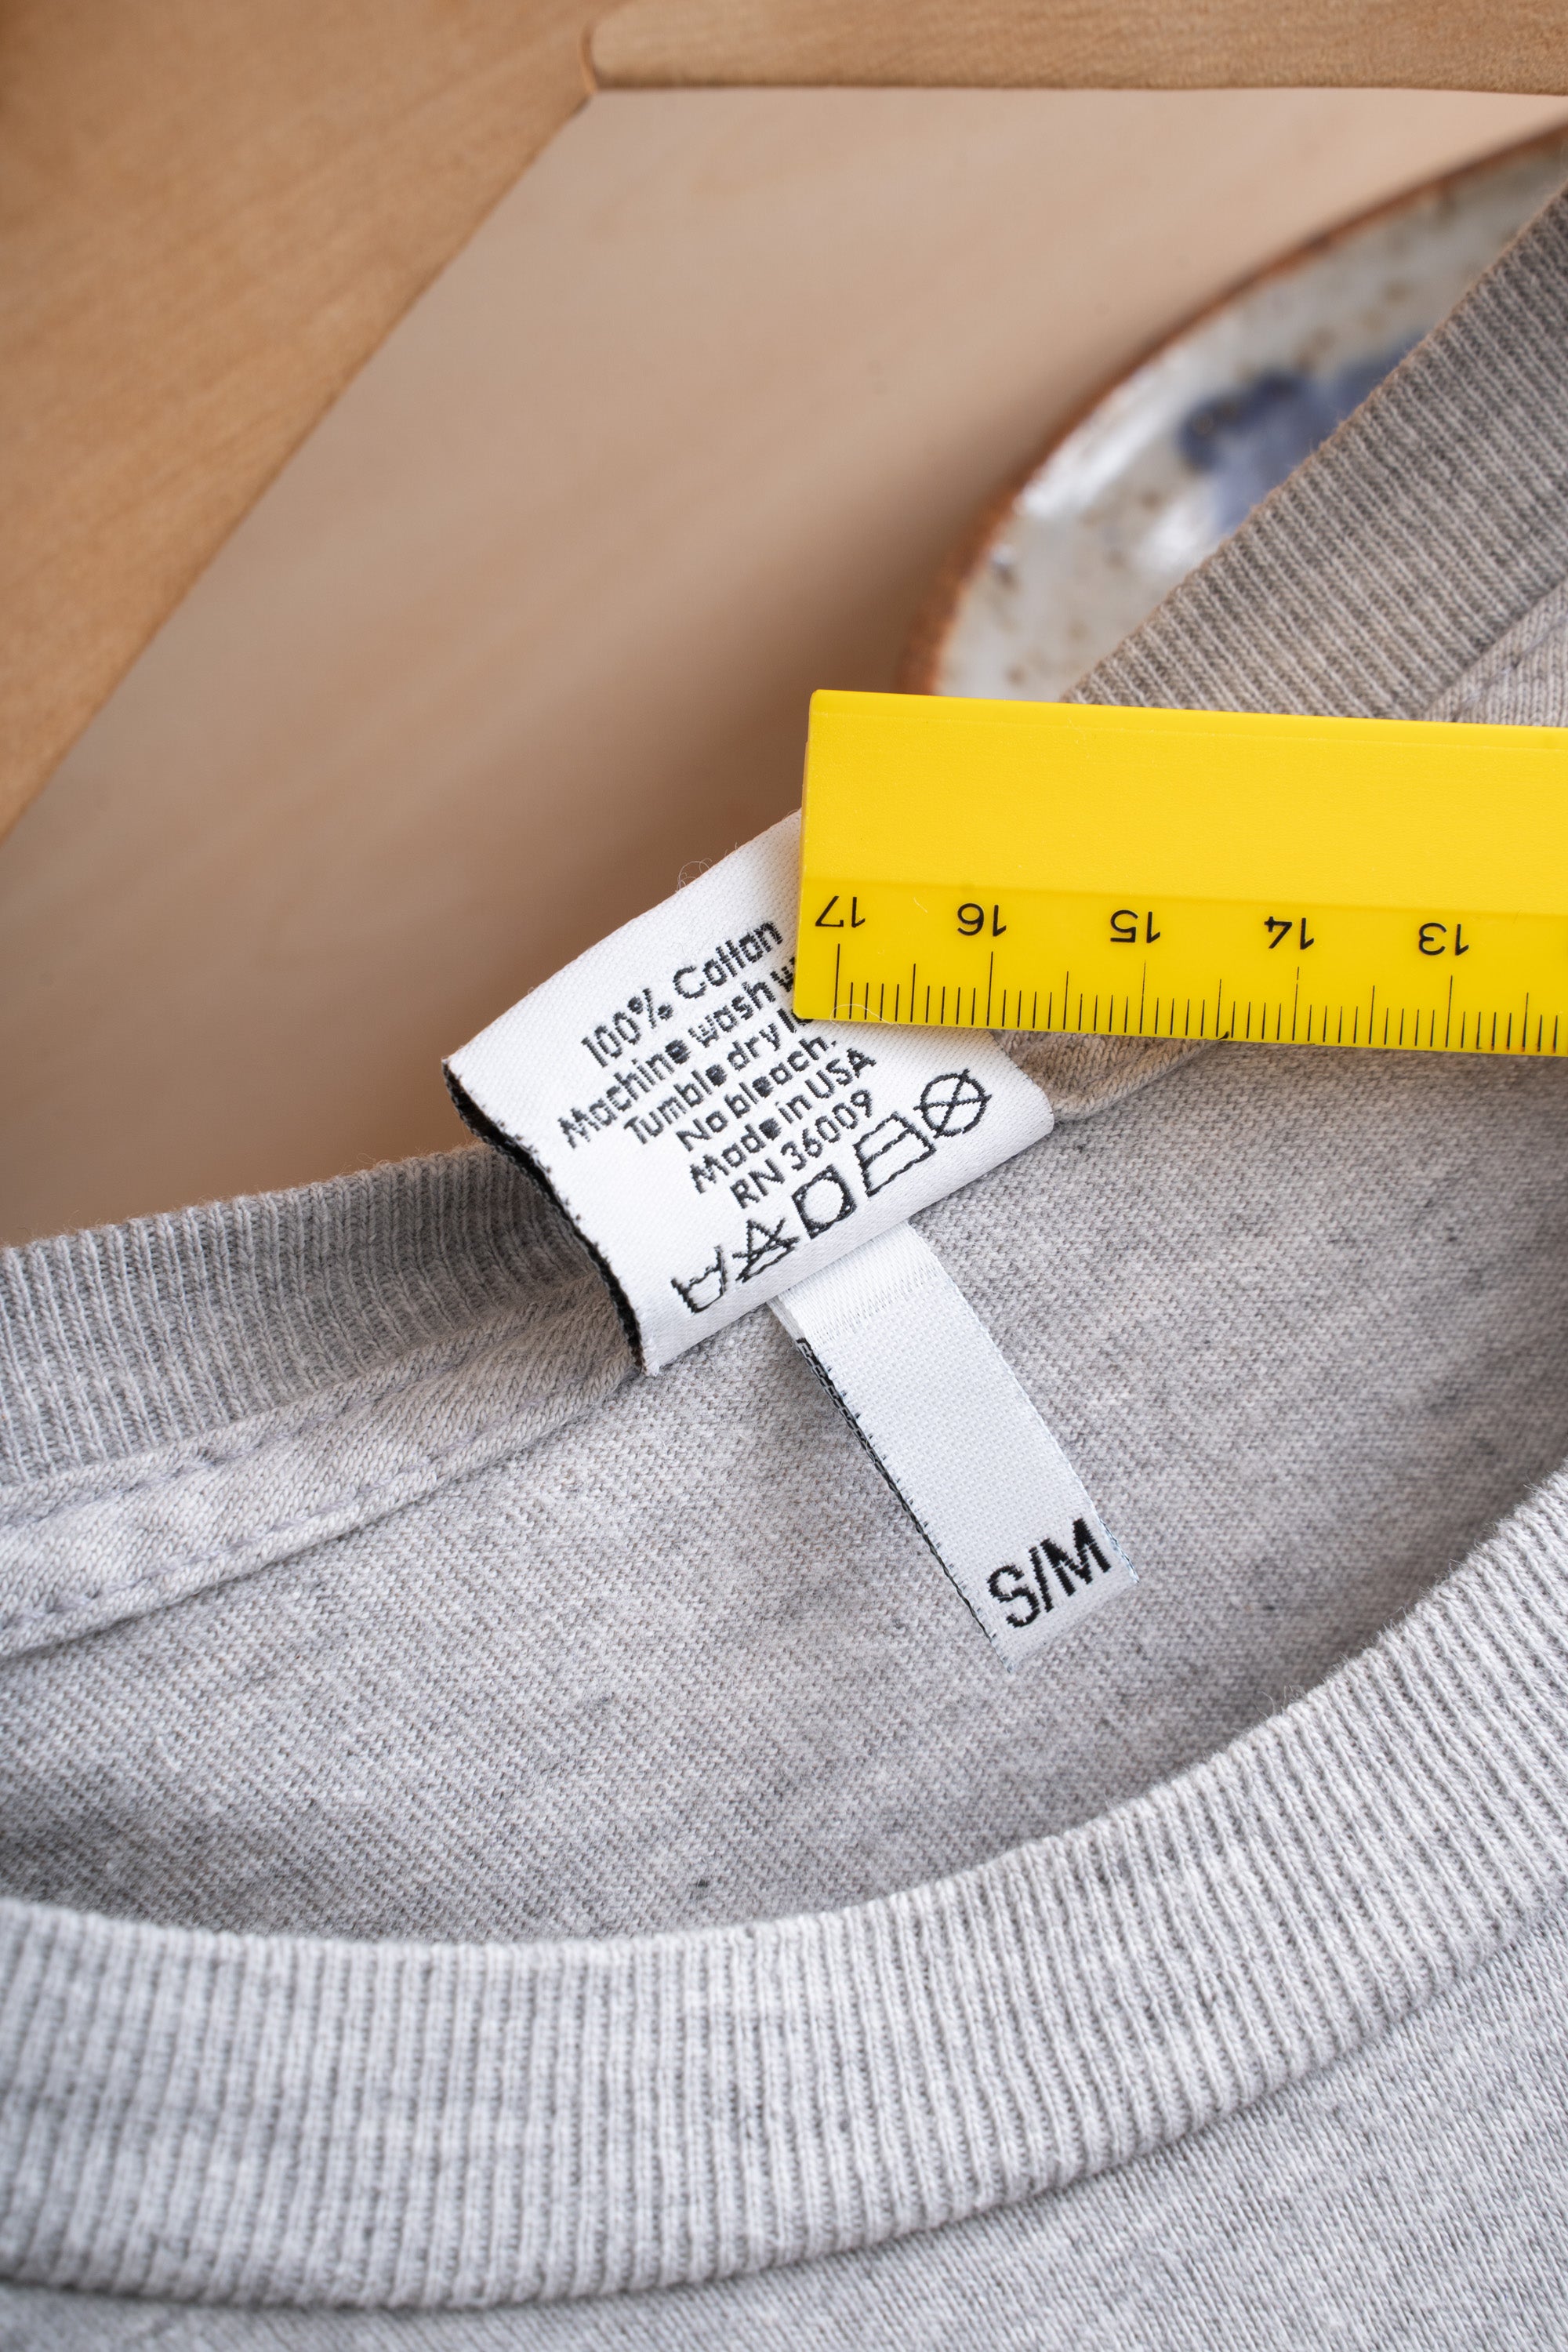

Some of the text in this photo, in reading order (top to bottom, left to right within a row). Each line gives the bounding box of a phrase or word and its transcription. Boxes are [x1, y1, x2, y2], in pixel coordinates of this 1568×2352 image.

[815, 895, 1469, 956] 13 14 15 16 17
[581, 988, 673, 1068] 100%
[672, 920, 782, 1000] Cotton
[557, 981, 776, 1149] Machine wash
[624, 1064, 728, 1145] Tumble
[727, 1022, 781, 1071] dry
[676, 1036, 837, 1152] No bleach.
[689, 1047, 877, 1194] Made in USA
[729, 1089, 873, 1210] RN 36009
[986, 1517, 1112, 1628] S/M
